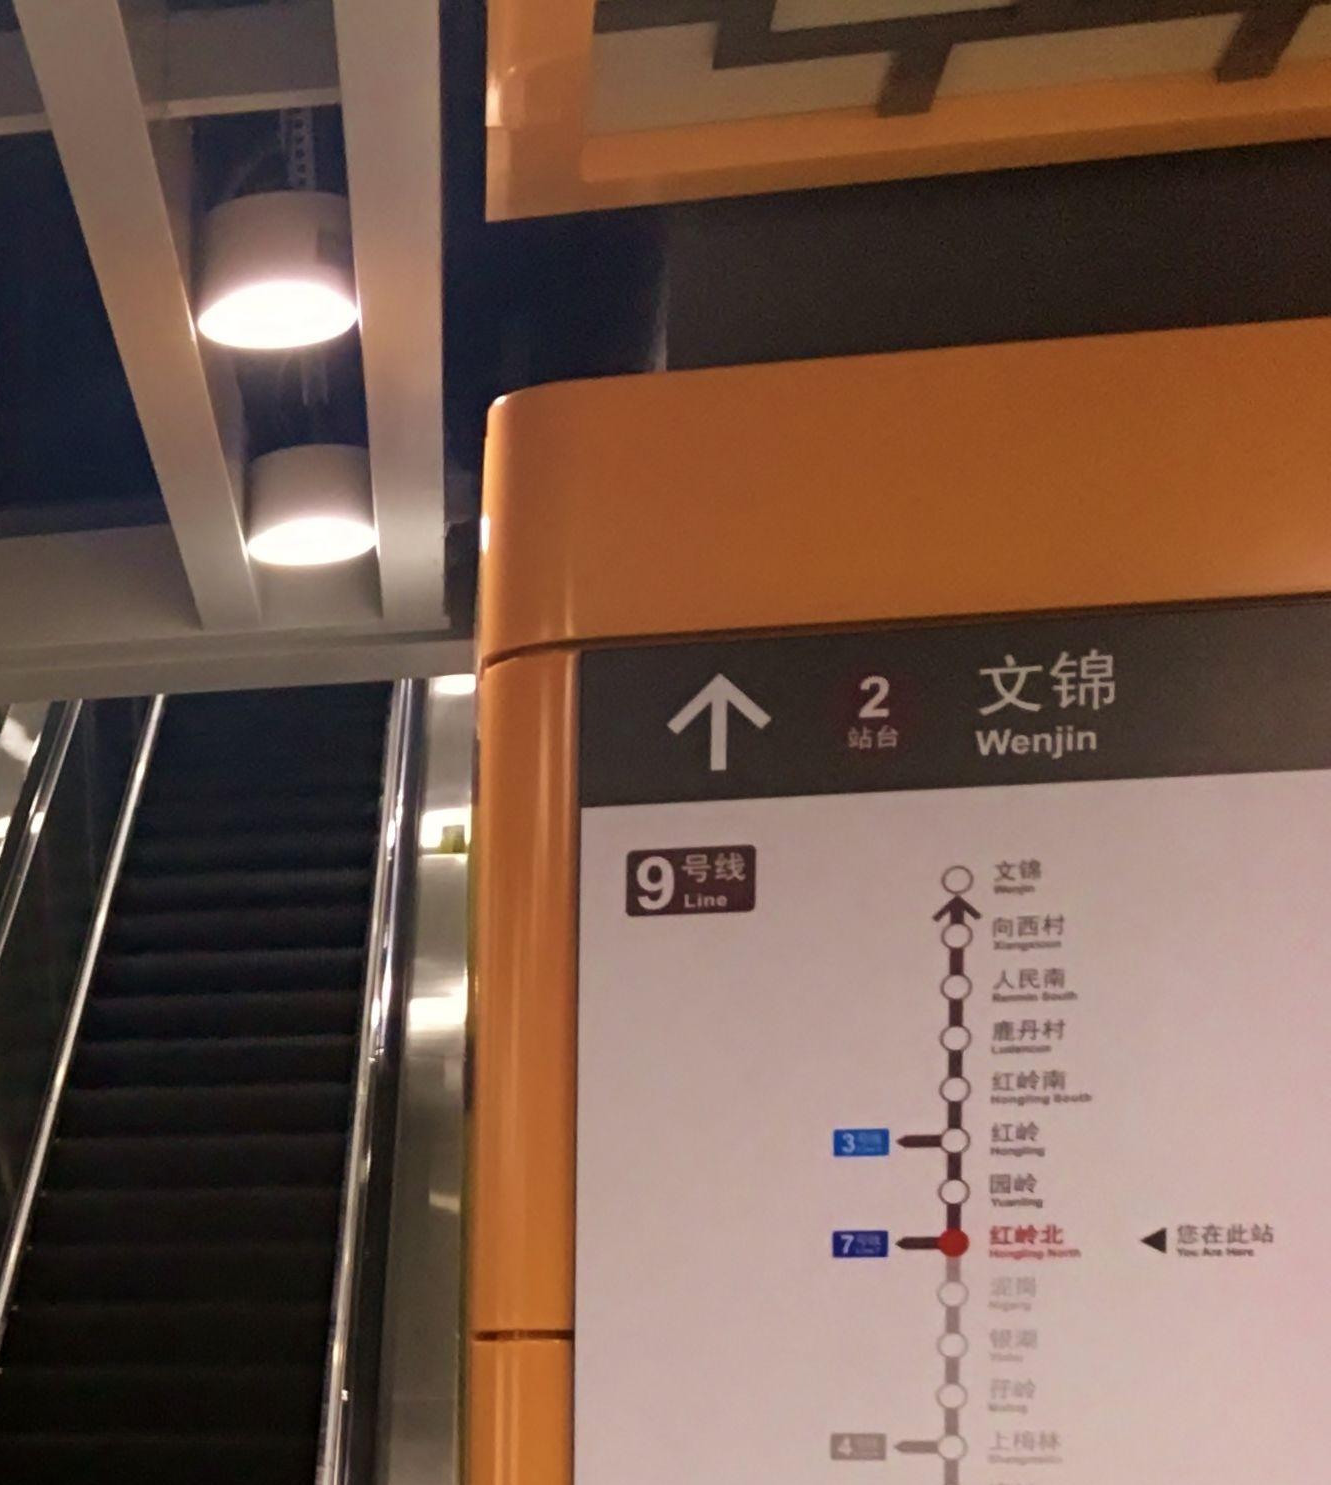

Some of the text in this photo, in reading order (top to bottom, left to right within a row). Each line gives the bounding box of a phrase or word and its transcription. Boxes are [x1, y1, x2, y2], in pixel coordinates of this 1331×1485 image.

[977, 649, 1118, 715] 文锦
[858, 676, 891, 719] 2
[847, 725, 900, 750] 站台
[976, 726, 1099, 760] Wenjin
[994, 860, 1042, 881] 文锦
[636, 852, 747, 911] 9 号线
[683, 893, 729, 909] Line
[992, 914, 1064, 937] 向西村
[992, 968, 1065, 989] 人民南
[992, 1019, 1065, 1041] 鹿丹村
[991, 1070, 1066, 1091] 红岭南
[991, 1121, 1039, 1142] 红岭
[841, 1132, 856, 1153] 3
[989, 1173, 1037, 1194] 园岭
[840, 1233, 855, 1254] 7
[989, 1224, 1064, 1245] 红岭北
[1177, 1223, 1275, 1245] 您在此站
